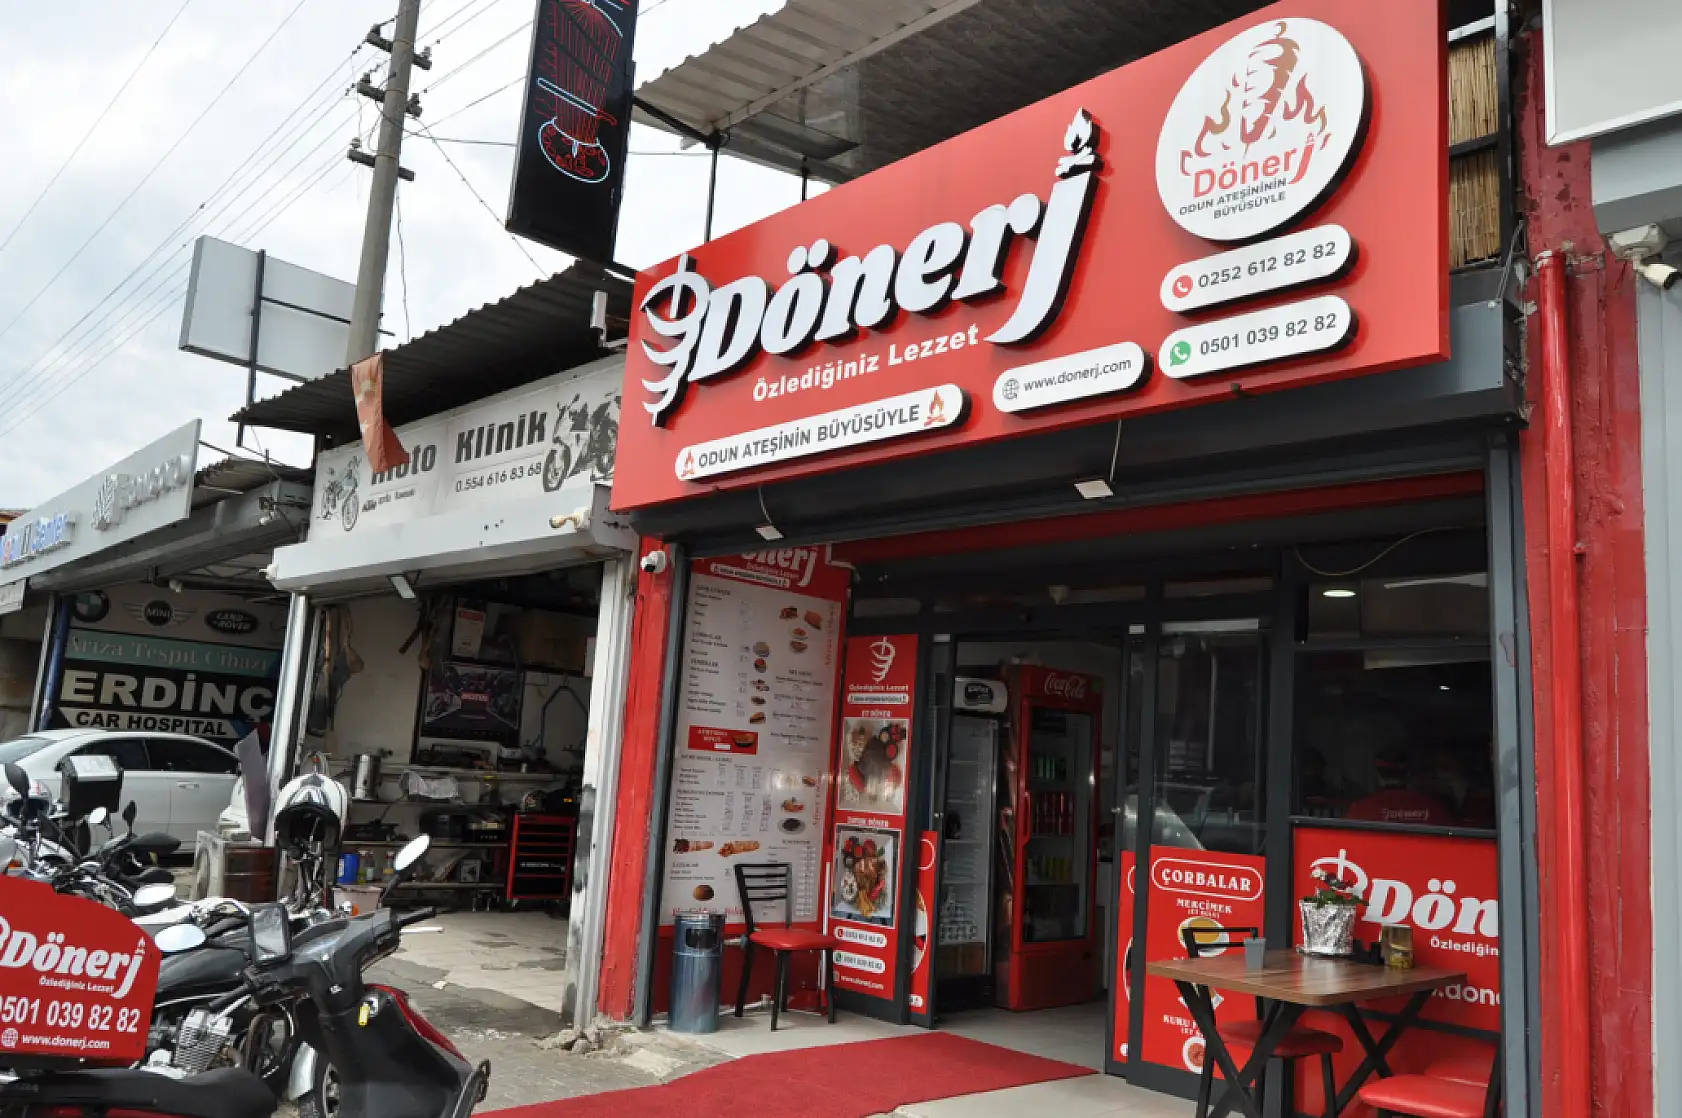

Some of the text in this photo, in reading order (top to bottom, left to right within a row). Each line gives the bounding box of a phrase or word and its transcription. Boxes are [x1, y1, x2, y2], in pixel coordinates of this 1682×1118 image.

[1193, 132, 1316, 198] Dönerj
[1179, 199, 1214, 216] ODUN
[1213, 191, 1286, 219] BÜYÜSÜYLE
[686, 108, 1097, 383] Dönerj
[1198, 240, 1336, 288] 0252 612 82 82
[1199, 312, 1337, 355] 0501 039 82 82
[752, 325, 979, 402] Özlediğiniz Lezzet
[1023, 357, 1132, 392] www.donerj.com
[455, 410, 548, 463] Klinik
[697, 403, 920, 469] ODUN ATEŞİNİN BÜYÜSÜYLE
[510, 466, 525, 481] 83
[741, 548, 818, 587] nerj
[146, 607, 172, 618] MINI
[216, 612, 245, 621] LAND
[216, 620, 251, 630] ROVER
[60, 669, 274, 722] ERDİNÇ
[76, 711, 228, 737] CAR HOSPITAL
[1161, 868, 1251, 892] ÇORBALAR
[1, 931, 145, 999] Dönerj
[39, 975, 114, 992] Özlediğiniz Lezzet
[0, 996, 141, 1033] 501 039 82 82
[22, 1034, 110, 1050] www.donerj.com
